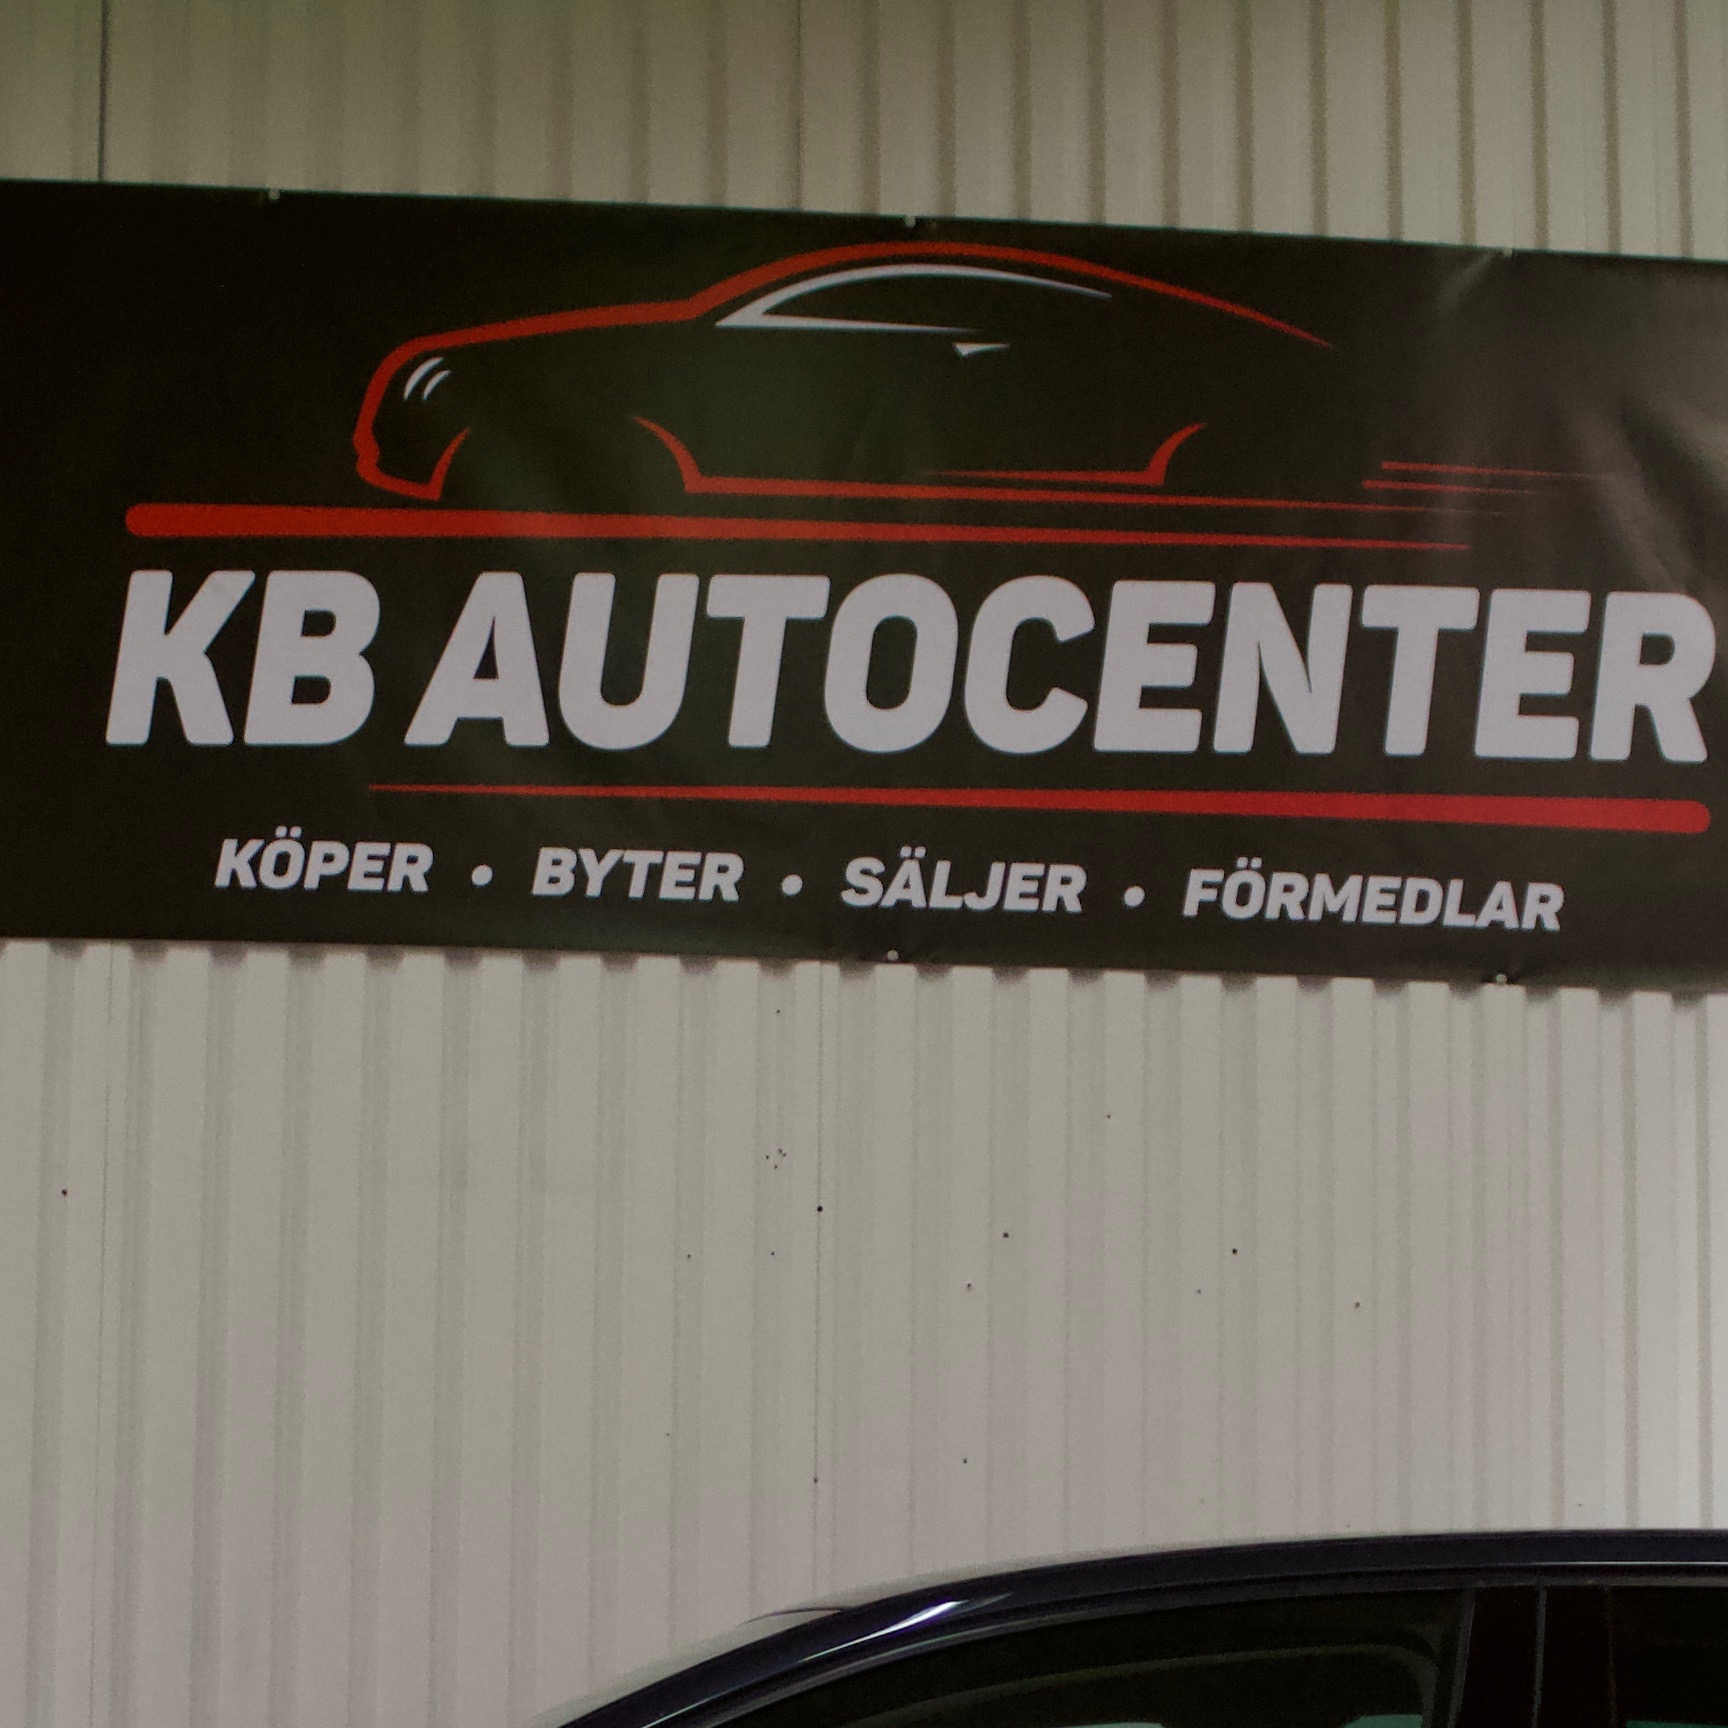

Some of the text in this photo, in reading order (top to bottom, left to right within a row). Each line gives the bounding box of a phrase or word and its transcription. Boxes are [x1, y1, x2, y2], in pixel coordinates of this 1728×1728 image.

[105, 570, 1716, 763] KB AUTOCENTER
[214, 826, 1564, 931] KÖPER BYTER SÄLJER FÖRMEDLAR
